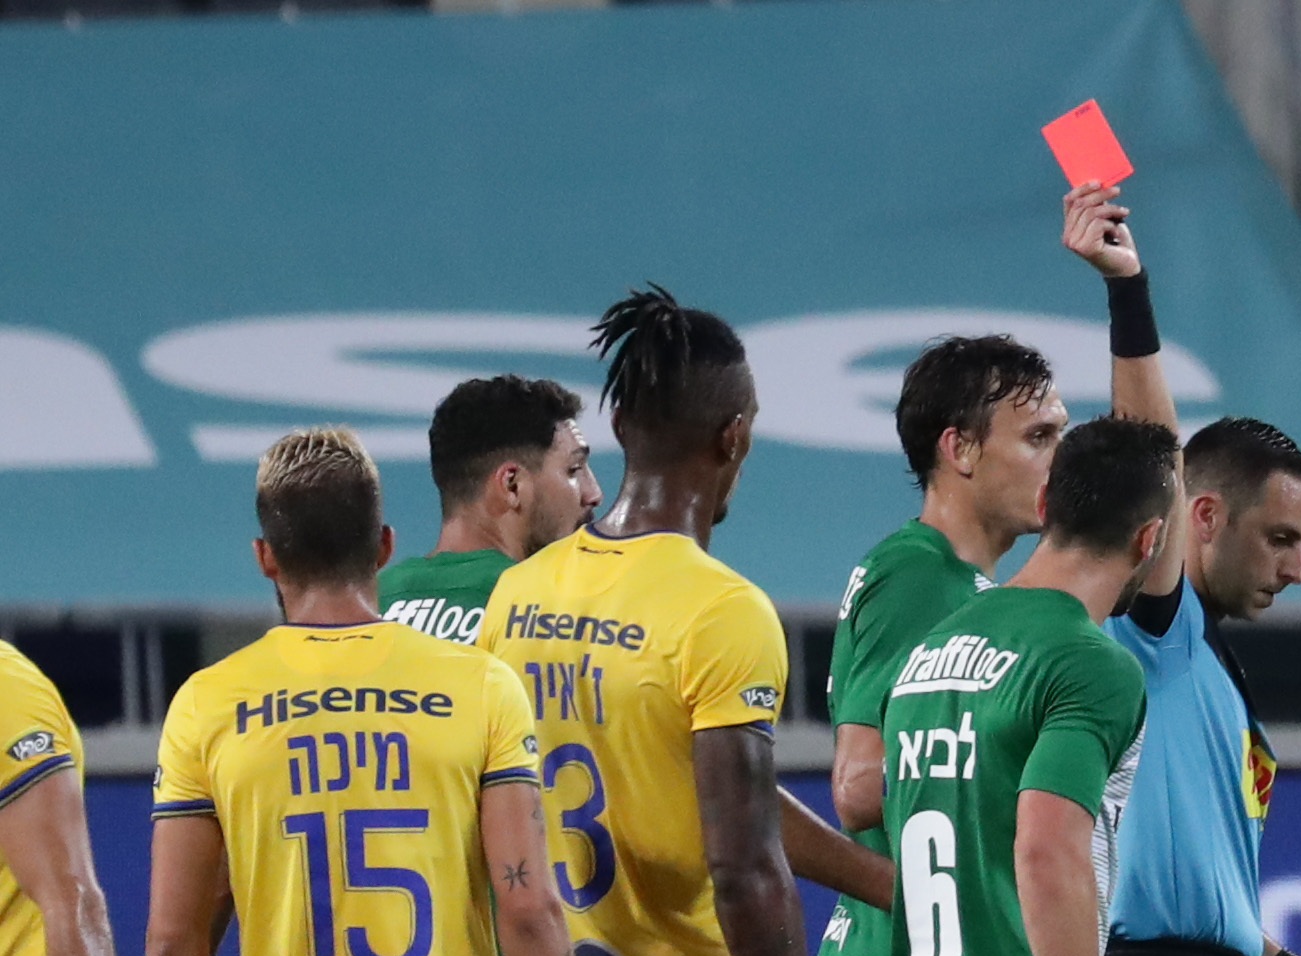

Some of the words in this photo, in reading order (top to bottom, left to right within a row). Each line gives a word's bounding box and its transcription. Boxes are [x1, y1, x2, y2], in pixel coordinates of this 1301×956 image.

[379, 598, 485, 645] ffilog
[505, 603, 645, 651] Hisense
[890, 634, 1020, 698] traffilog
[236, 686, 454, 735] Hisense
[287, 731, 411, 796] מיכה
[898, 711, 977, 781] לביא
[543, 742, 616, 914] 3
